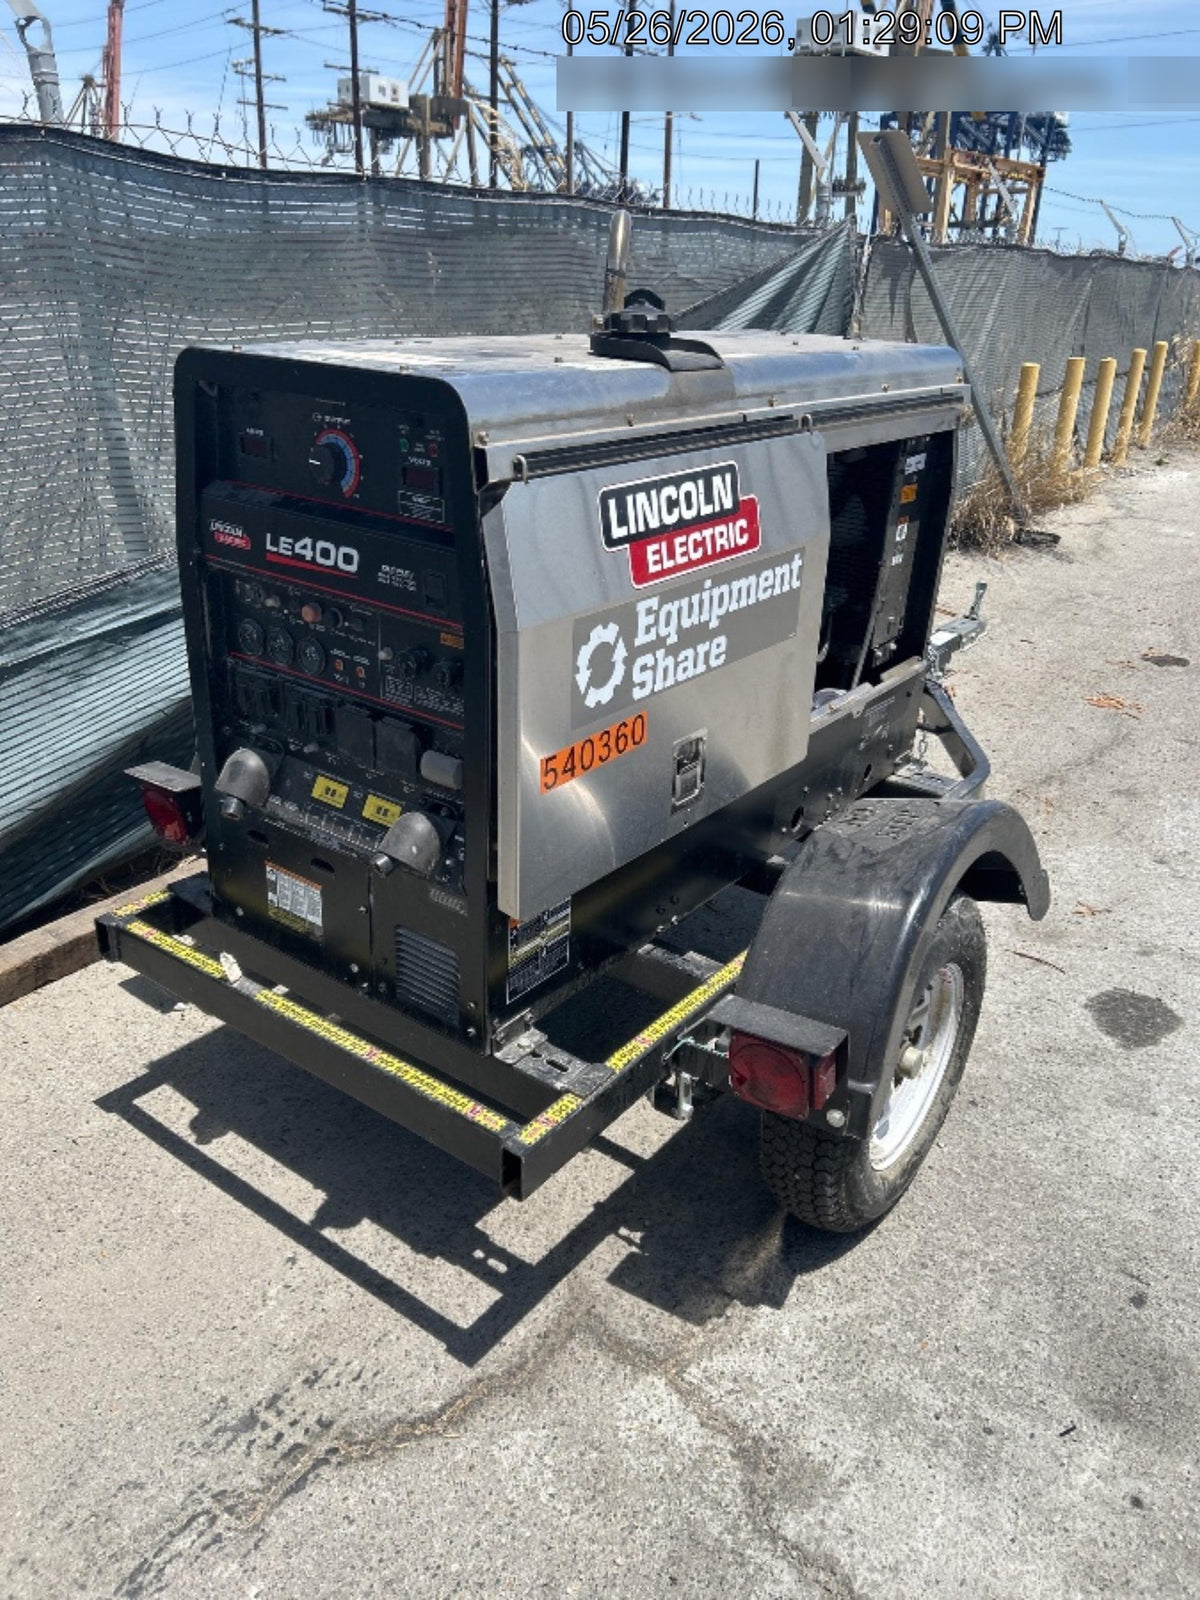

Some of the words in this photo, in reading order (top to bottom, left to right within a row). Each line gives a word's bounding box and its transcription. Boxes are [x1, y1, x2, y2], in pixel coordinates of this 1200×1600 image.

[608, 473, 733, 539] LINCOLN
[266, 533, 360, 573] LE400
[647, 519, 749, 574] ELECTRIC
[634, 553, 802, 647] Equipment
[632, 635, 727, 700] Share
[544, 714, 645, 790] 540360
